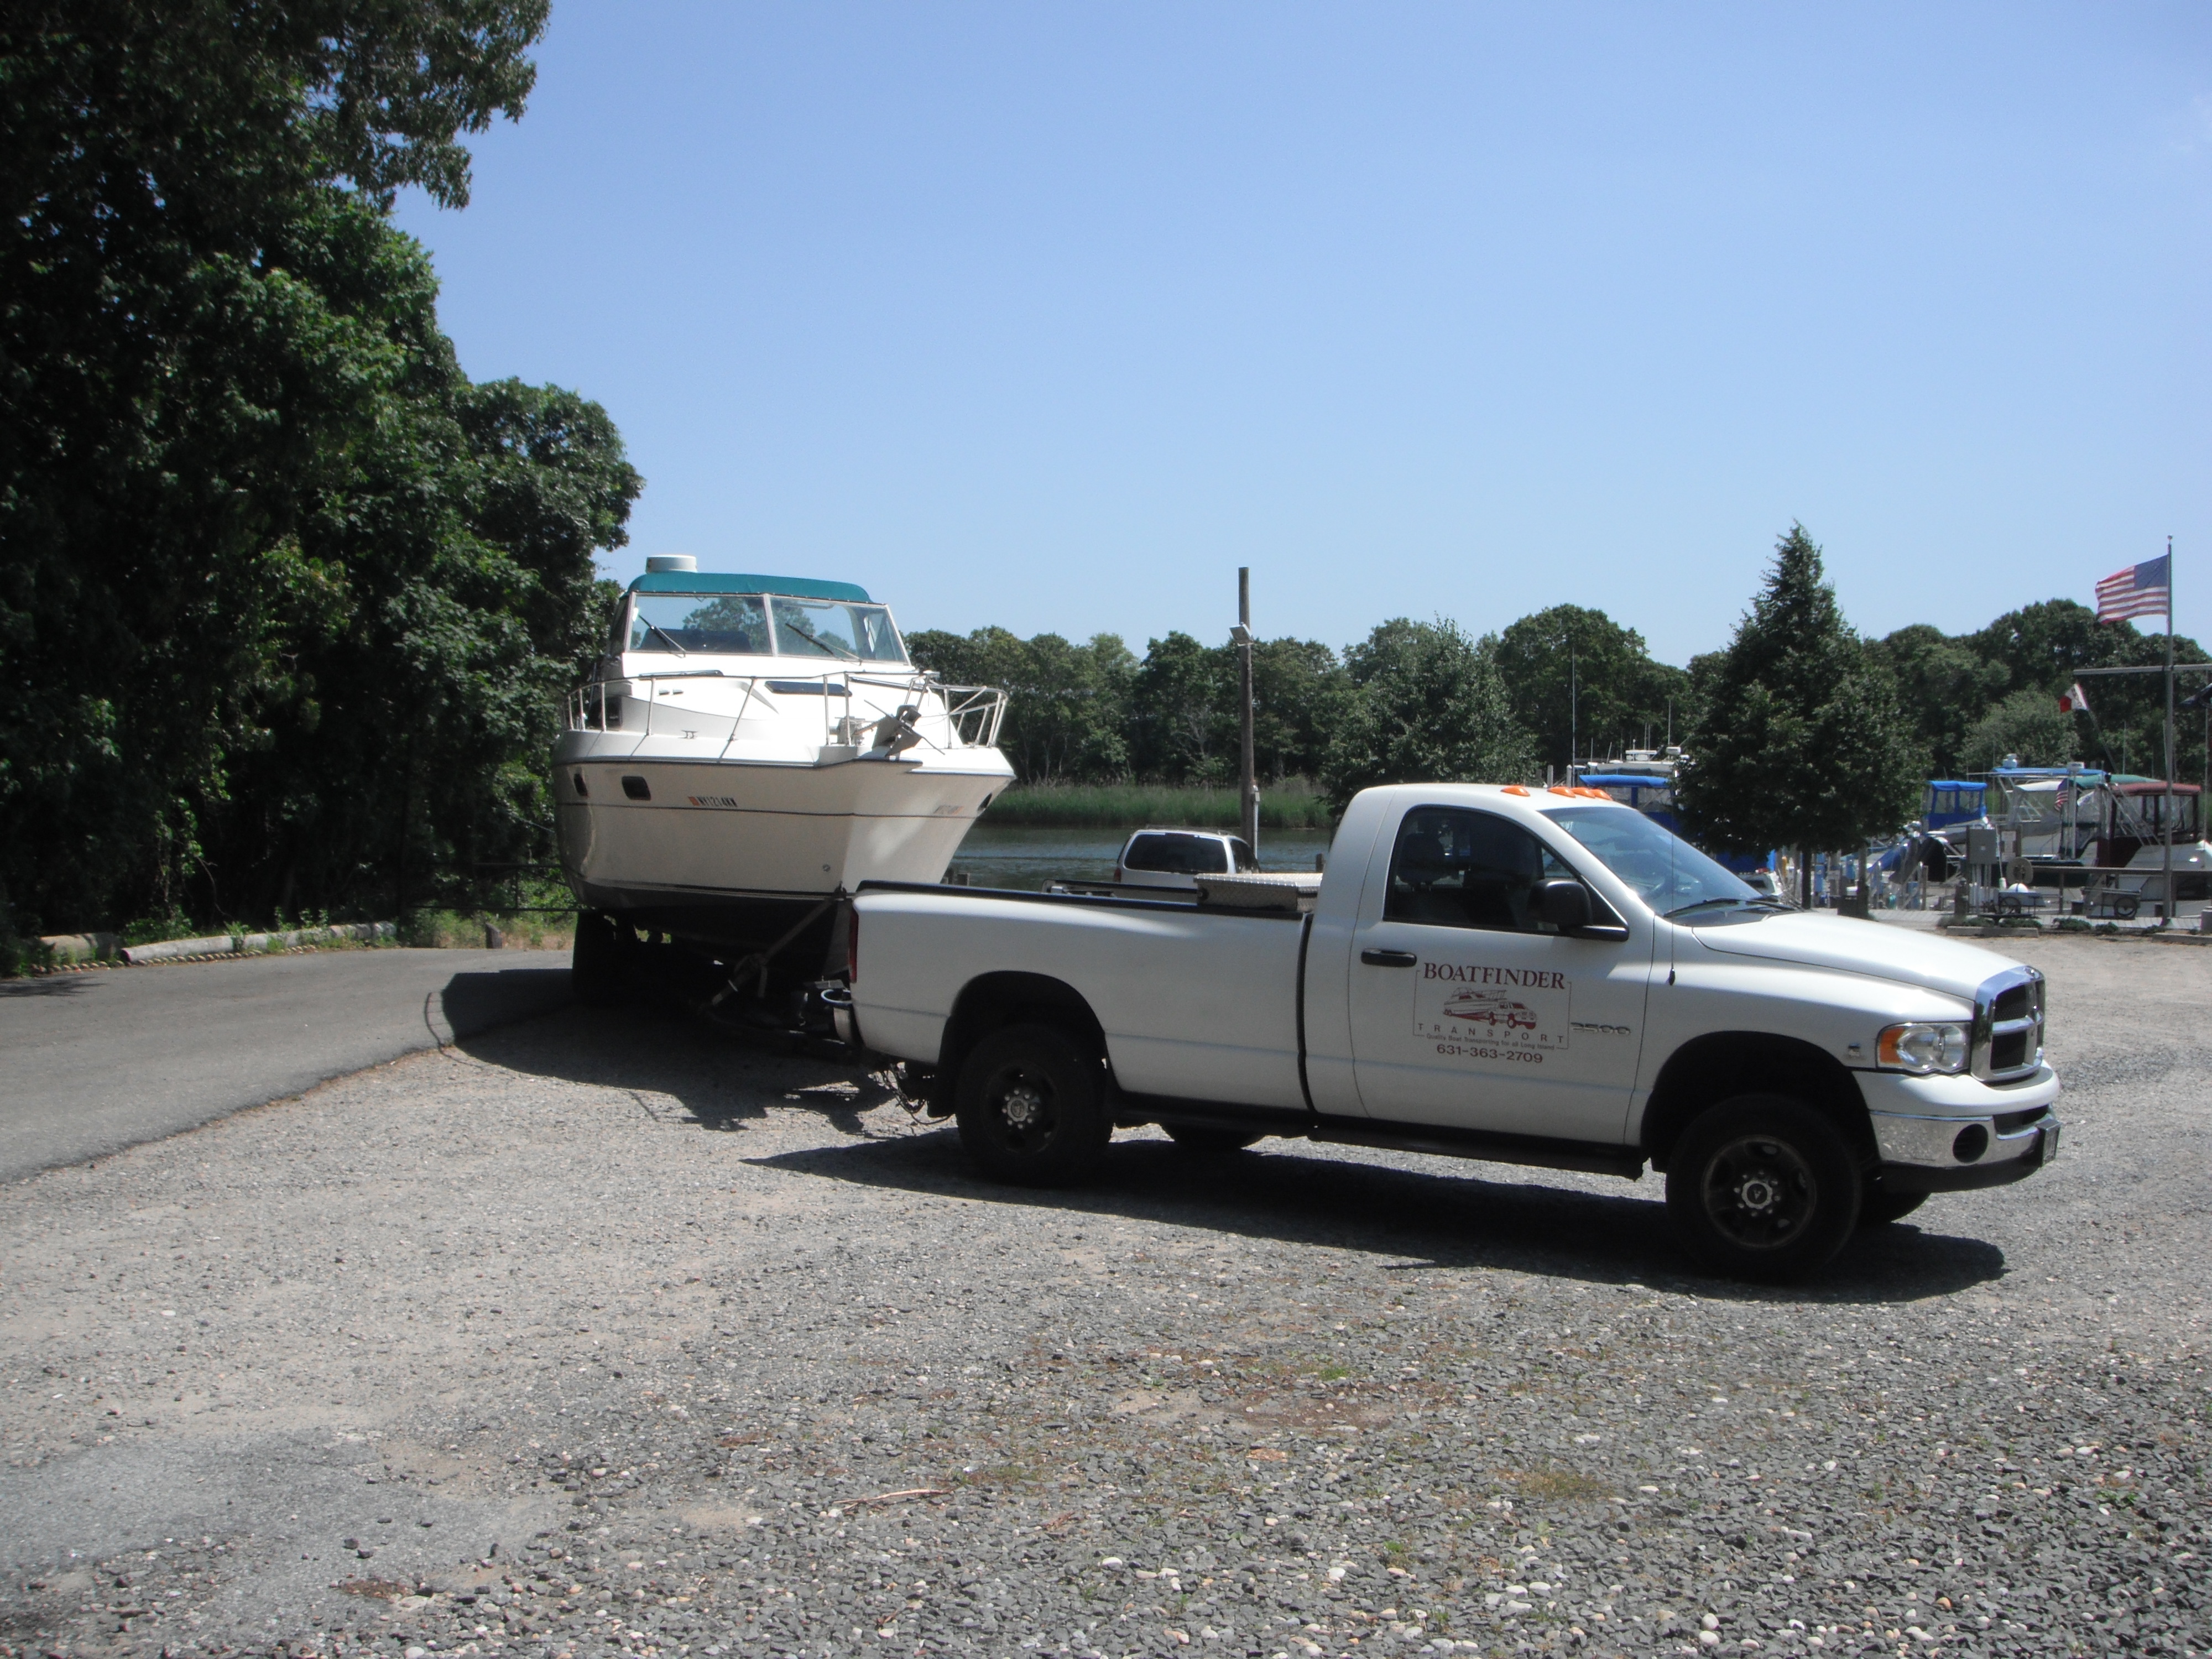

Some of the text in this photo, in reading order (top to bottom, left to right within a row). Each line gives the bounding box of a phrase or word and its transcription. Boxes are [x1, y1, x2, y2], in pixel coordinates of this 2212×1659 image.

[1423, 962, 1566, 989] BOATFINDER
[1418, 1022, 1563, 1044] TRANSPORT
[1570, 1021, 1631, 1036] 2500
[1464, 1036, 1499, 1046] Transporting
[1437, 1044, 1543, 1063] 631-363-2709
